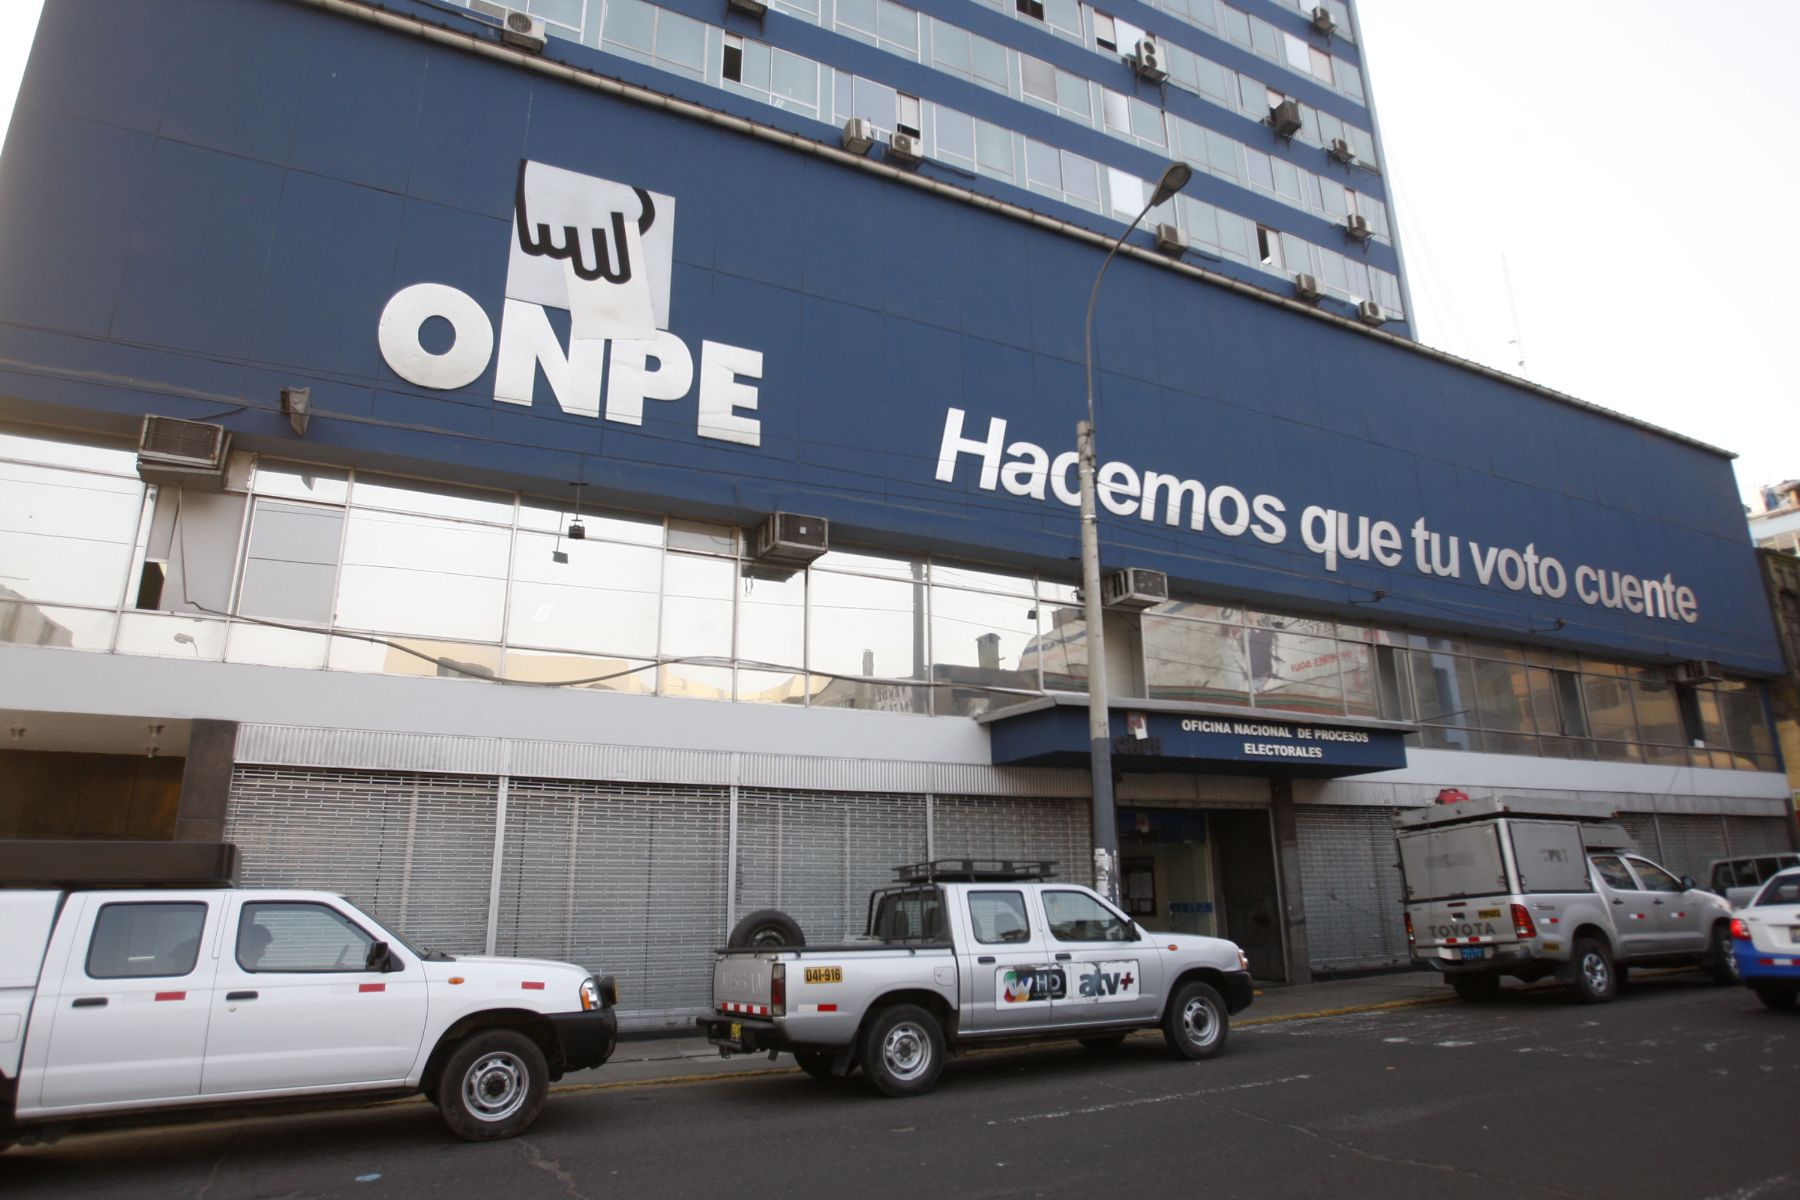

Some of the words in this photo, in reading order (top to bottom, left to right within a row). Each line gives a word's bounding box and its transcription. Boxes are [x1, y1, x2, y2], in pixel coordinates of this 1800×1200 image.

[378, 283, 764, 447] ONPE
[936, 407, 1287, 545] Hacemos
[1301, 505, 1402, 572] que
[1411, 517, 1460, 578] tu
[1469, 542, 1567, 599] voto
[1575, 565, 1698, 623] cuente
[1182, 719, 1231, 733] OFICINA
[1234, 723, 1292, 738] NACIONAL
[1297, 728, 1312, 739] DE
[1315, 730, 1369, 743] PROCESOS
[1244, 743, 1323, 758] ELECTORALES
[1428, 923, 1496, 938] TOYOTA
